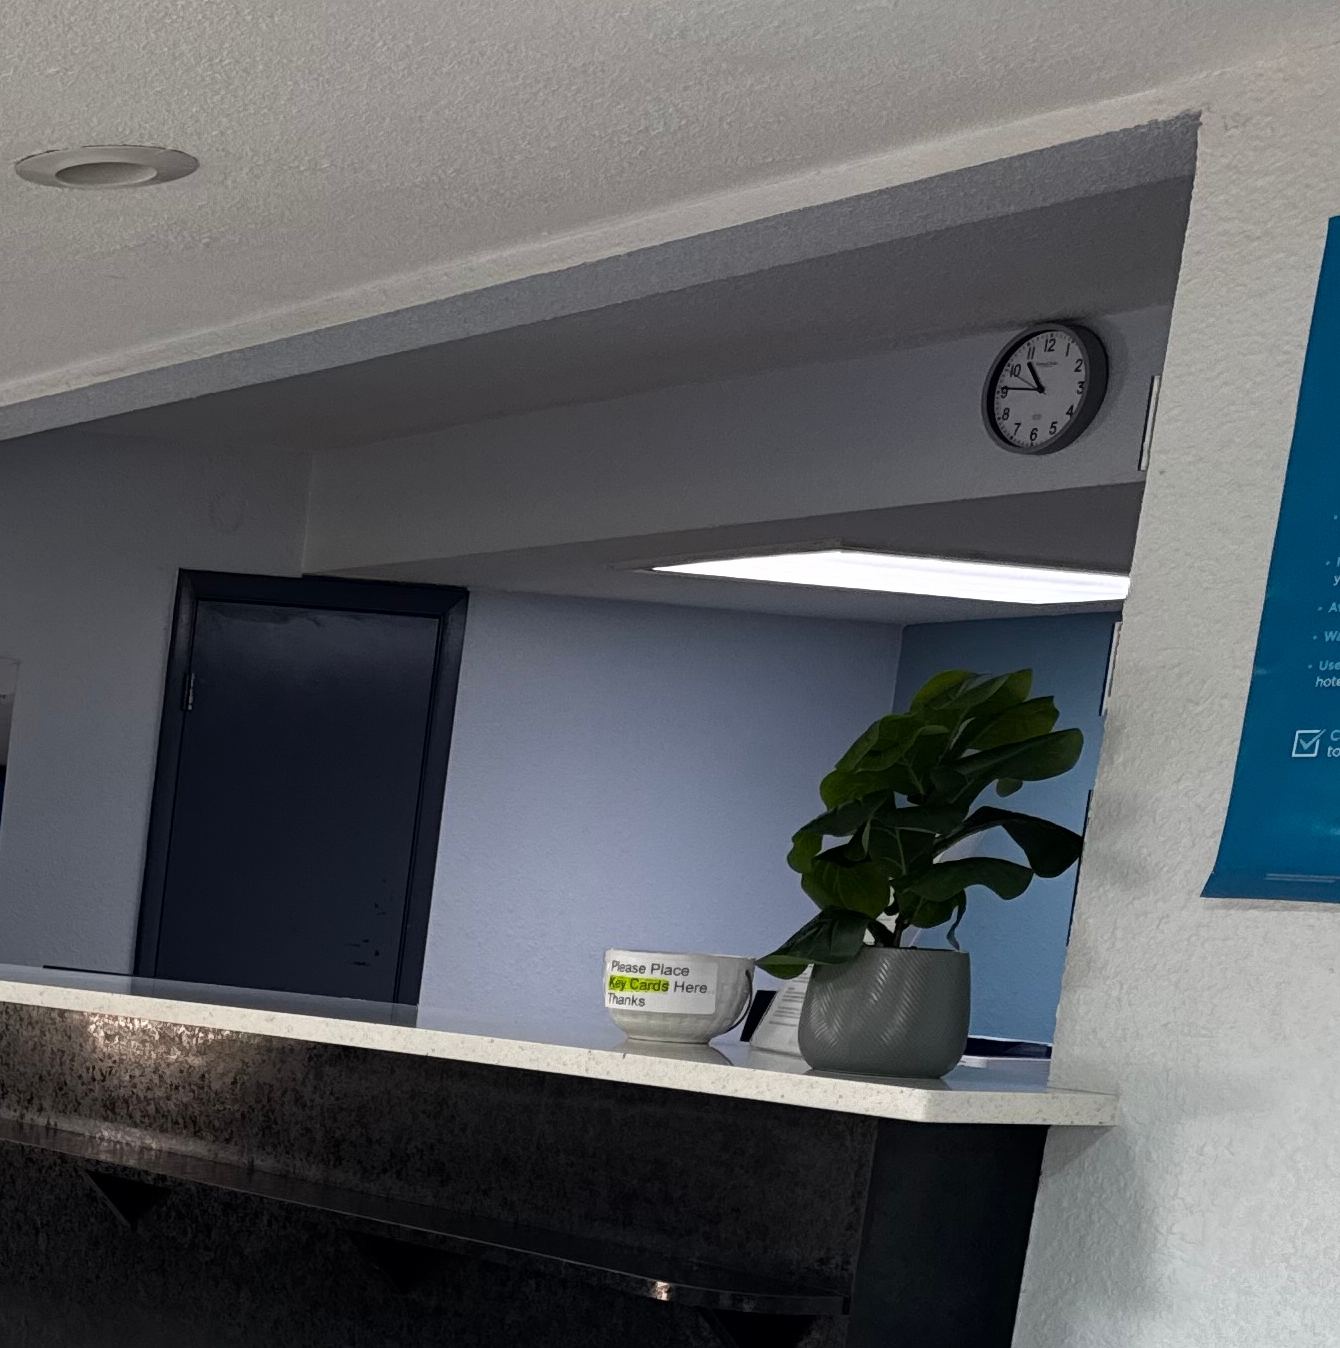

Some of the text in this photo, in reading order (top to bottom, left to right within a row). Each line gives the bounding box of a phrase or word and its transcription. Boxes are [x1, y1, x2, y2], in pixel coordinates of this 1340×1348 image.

[1044, 339, 1056, 352] 12
[1065, 343, 1070, 357] 1
[1027, 347, 1035, 360] 11
[1010, 364, 1021, 378] 10
[1074, 359, 1083, 372] 2
[1001, 386, 1009, 399] 9
[1077, 381, 1085, 394] 3
[1002, 407, 1010, 420] 8
[1066, 405, 1074, 418] 4
[1014, 423, 1021, 436] 7
[1030, 428, 1038, 441] 6
[1049, 421, 1058, 435] 5
[611, 960, 690, 977] Please Place
[609, 975, 708, 994] Key Cards Here
[607, 992, 646, 1007] Thanks
